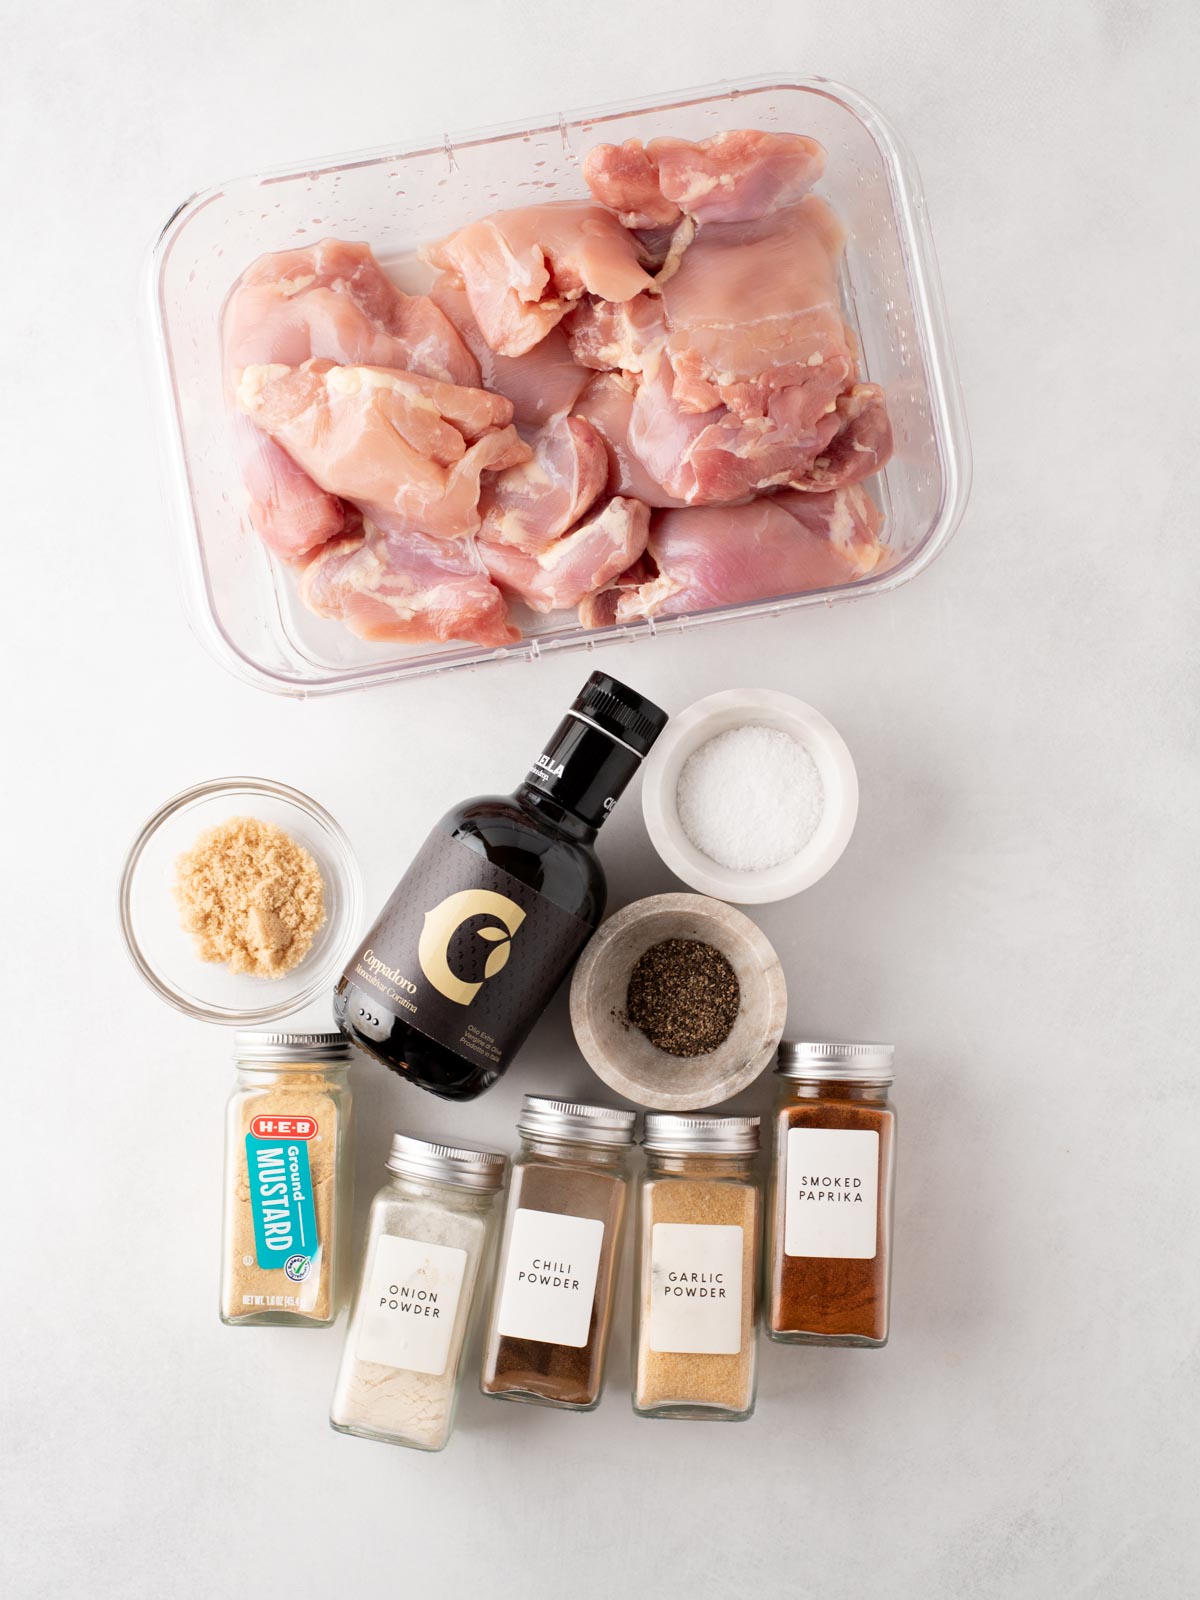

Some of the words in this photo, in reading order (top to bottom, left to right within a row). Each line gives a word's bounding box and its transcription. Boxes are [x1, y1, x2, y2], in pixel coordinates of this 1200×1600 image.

[363, 949, 417, 994] Coppadoro
[355, 962, 388, 992] Monocultivar
[386, 987, 418, 1014] Coratina
[465, 1030, 486, 1047] Vergine
[467, 1024, 480, 1035] Olio
[480, 1031, 495, 1044] Extra
[460, 1036, 485, 1055] Prodotto
[287, 1145, 306, 1201] Ground
[801, 1175, 862, 1188] SMOKED
[256, 1147, 293, 1251] MUSTARD
[799, 1190, 863, 1202] PAPRIKA
[532, 1259, 571, 1274] CHILI
[518, 1271, 579, 1290] POWDER
[668, 1271, 723, 1283] GARLIC
[242, 1295, 254, 1305] NET
[389, 1284, 438, 1303] ONION
[664, 1286, 726, 1298] POWDER
[379, 1297, 440, 1319] POWDER
